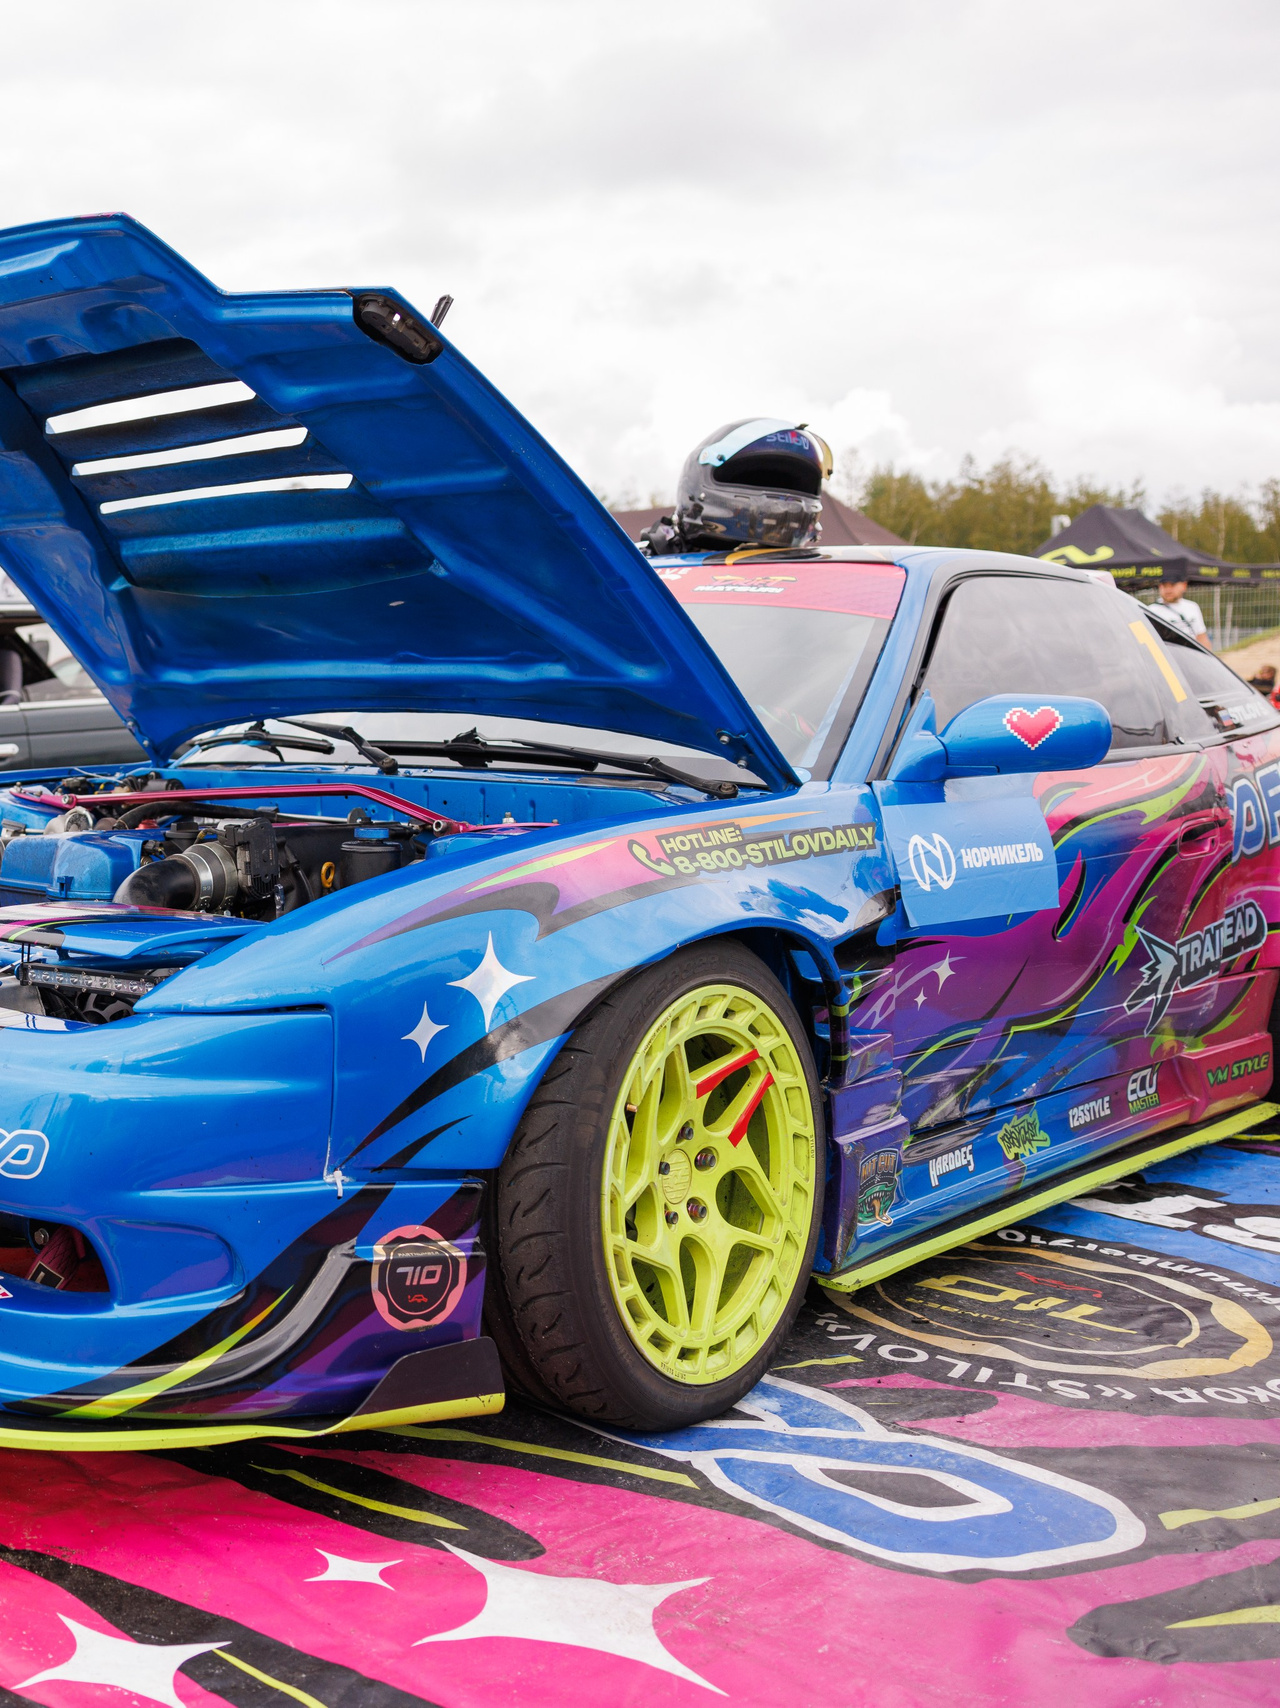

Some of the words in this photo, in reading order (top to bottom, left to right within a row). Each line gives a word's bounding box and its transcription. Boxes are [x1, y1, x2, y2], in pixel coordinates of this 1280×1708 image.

[661, 826, 743, 854] HOTLINE:
[676, 826, 876, 876] 8-800-STILOVDAILY
[960, 841, 1045, 870] НОРНИКЕЛЬ
[1126, 1065, 1160, 1102] ECU
[1206, 1068, 1229, 1087] VM
[1231, 1053, 1270, 1079] STYLE
[1068, 1095, 1111, 1129] 125STYLE
[1128, 1092, 1161, 1115] MASTER
[395, 1264, 443, 1287] 710
